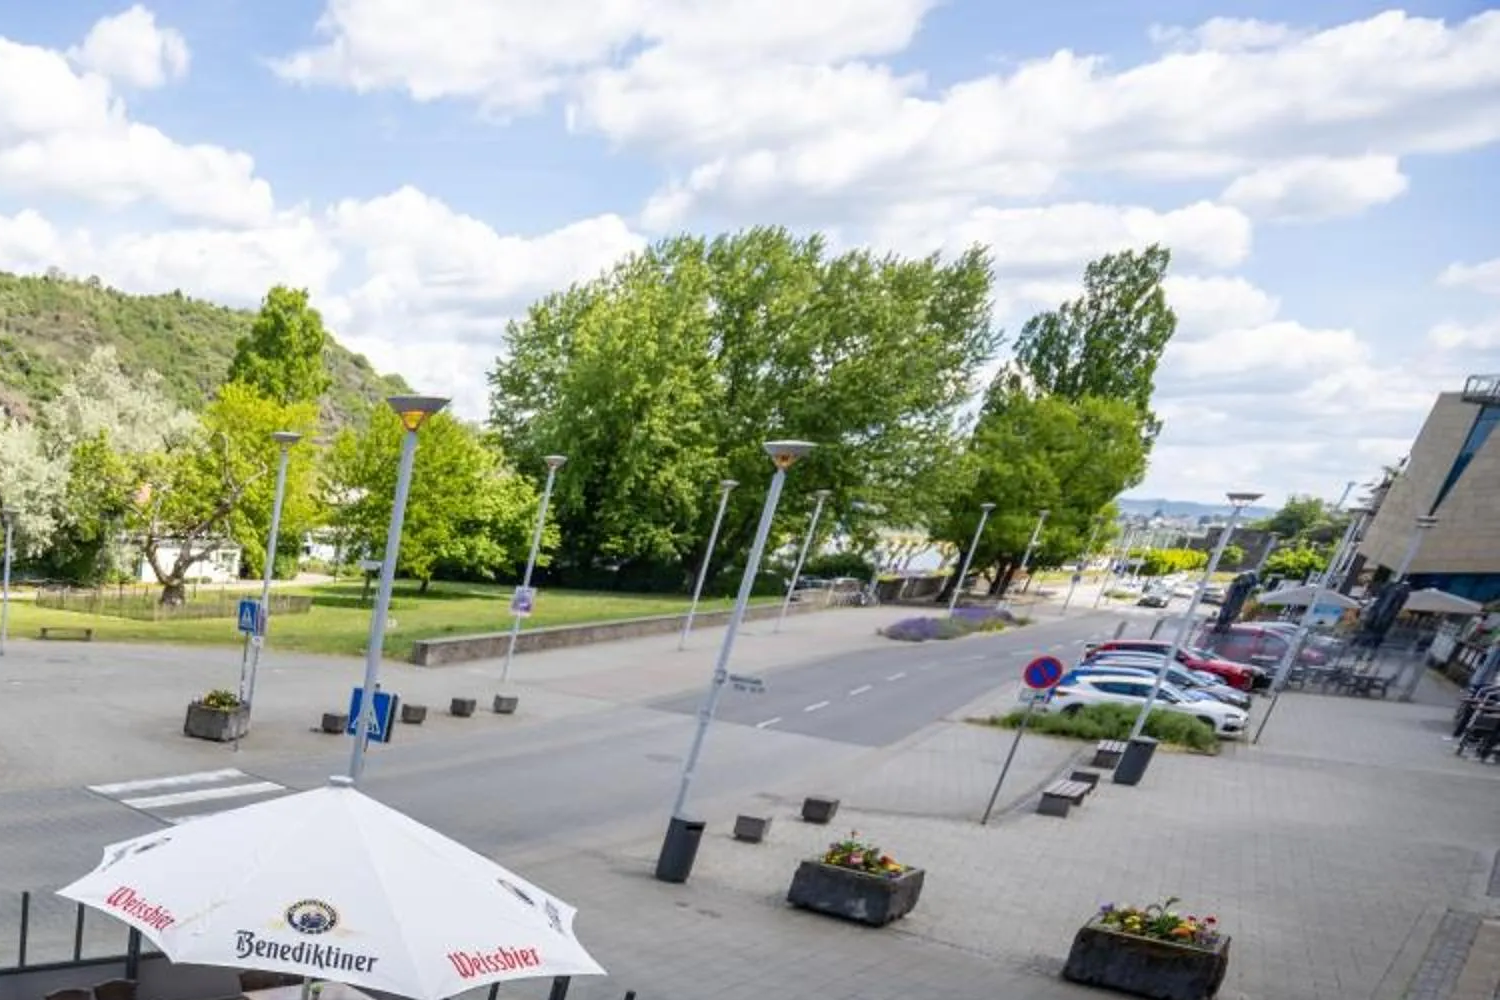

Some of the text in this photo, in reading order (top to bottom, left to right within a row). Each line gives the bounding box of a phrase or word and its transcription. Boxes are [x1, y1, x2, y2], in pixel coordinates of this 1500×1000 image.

[107, 886, 175, 929] Weissbier
[235, 929, 379, 973] Benediktiner
[447, 946, 540, 979] Weissbier
